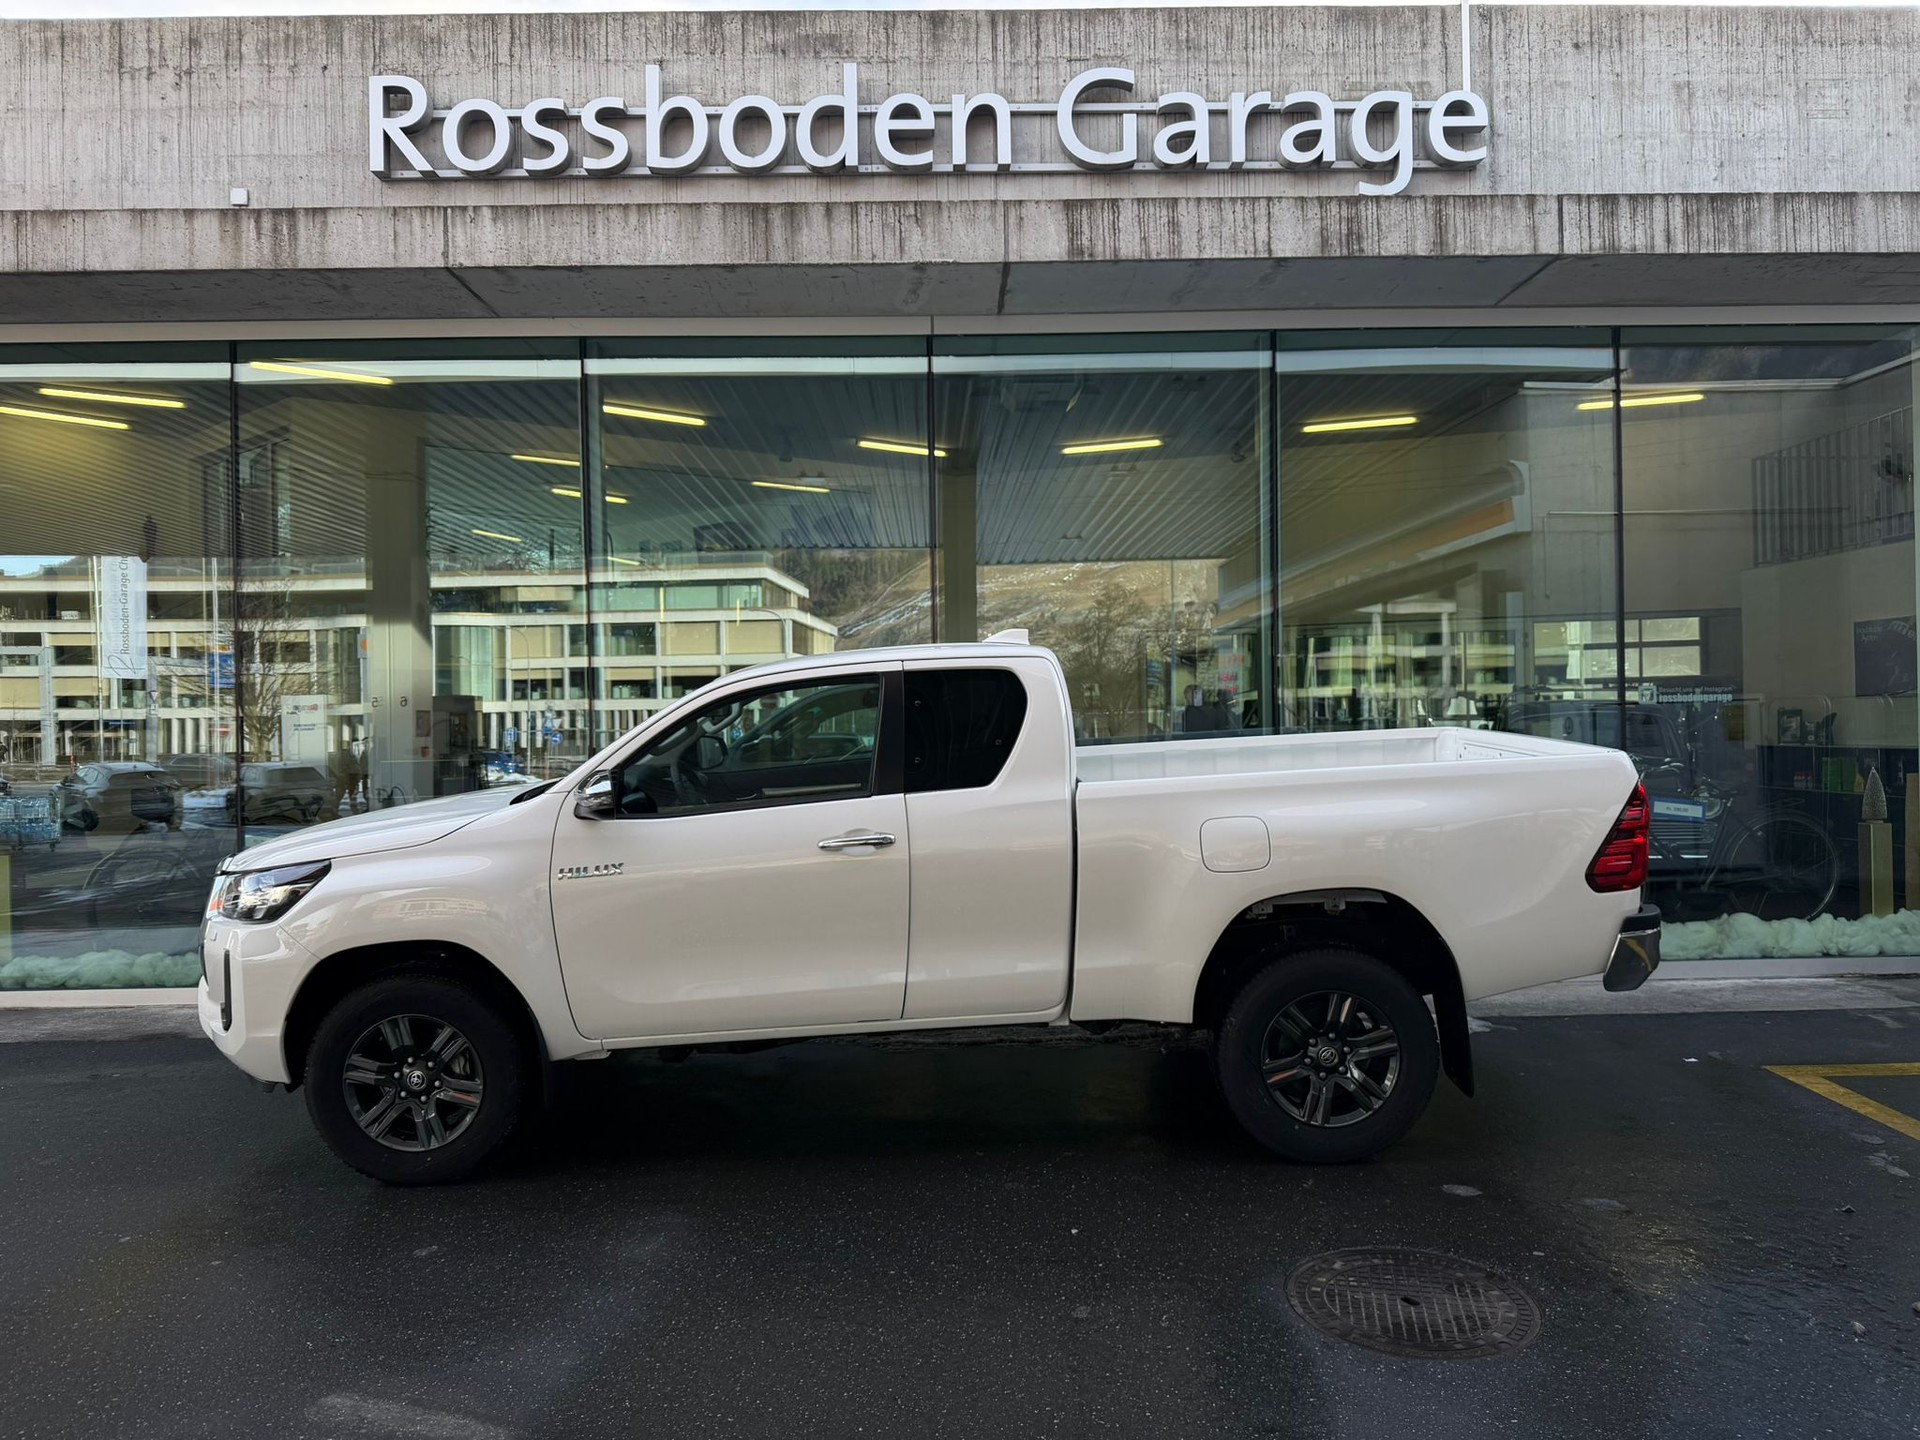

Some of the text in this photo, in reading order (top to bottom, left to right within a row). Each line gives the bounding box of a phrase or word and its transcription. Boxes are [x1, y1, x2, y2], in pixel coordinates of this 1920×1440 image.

[369, 62, 1489, 196] Rossboden Garage
[119, 572, 131, 655] Rossboden-Garage
[1659, 693, 1733, 704] rossbodengarage
[557, 862, 625, 881] HILUX
